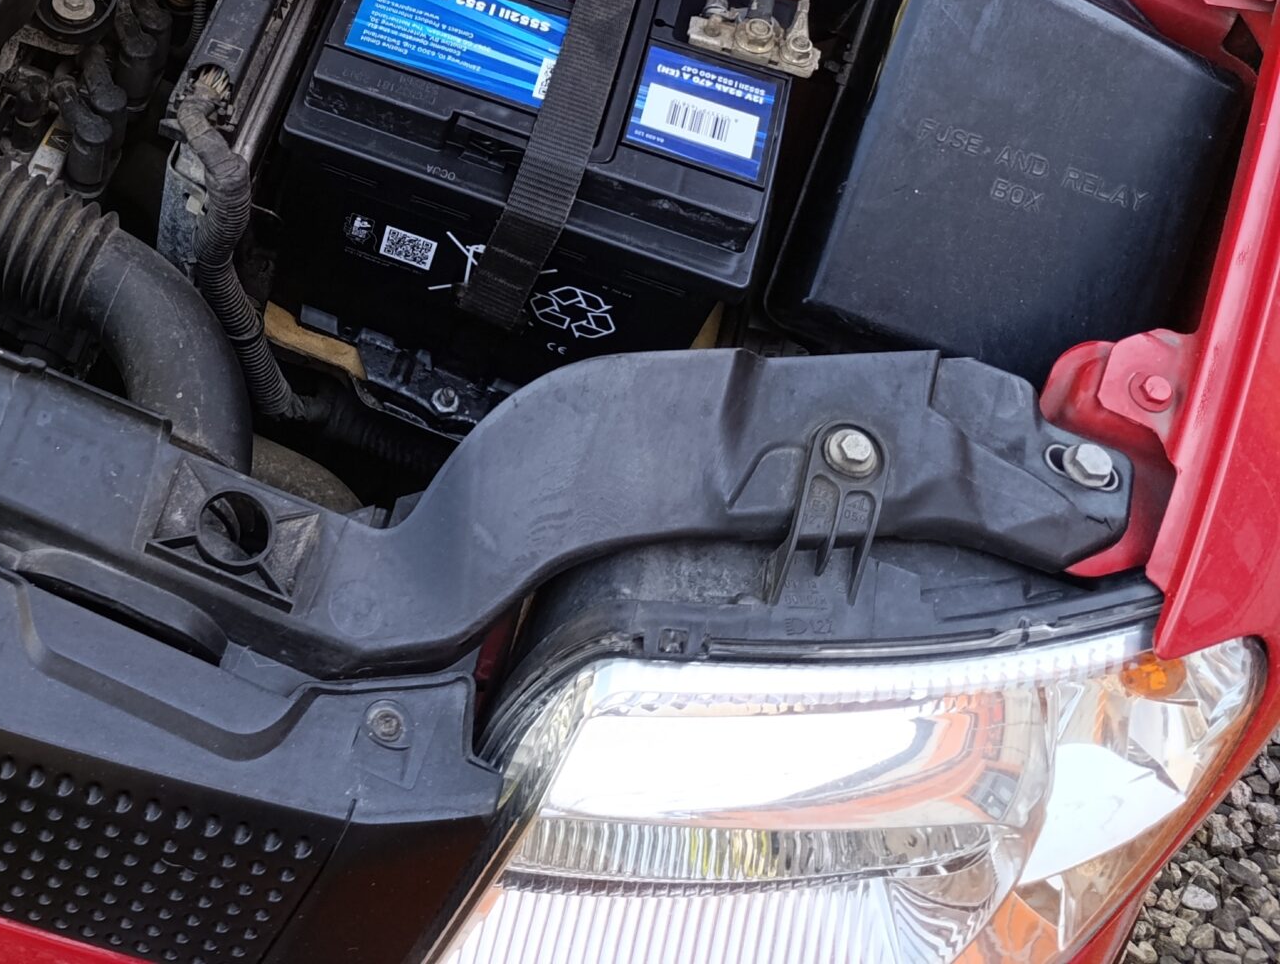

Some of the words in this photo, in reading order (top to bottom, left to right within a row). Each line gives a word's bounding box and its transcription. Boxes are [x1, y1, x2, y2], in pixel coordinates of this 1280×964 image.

[370, 9, 411, 27] Netherlands
[413, 14, 440, 27] Product
[411, 22, 423, 31] The
[446, 25, 474, 38] Contact
[359, 34, 381, 45] GmbH
[362, 28, 401, 45] Switzerland
[398, 30, 429, 45] Operator
[381, 41, 408, 54] Emotive
[428, 40, 461, 56] Economic
[655, 63, 680, 77] (EN)
[680, 63, 698, 74] 047
[698, 69, 717, 80] 400
[680, 71, 691, 81] A
[691, 75, 713, 88] 470
[717, 75, 733, 85] 552
[744, 92, 765, 104] 12V
[916, 118, 983, 156] FUSE
[994, 146, 1050, 178] AND
[1060, 168, 1151, 212] RELAY
[990, 178, 1045, 213] BOX
